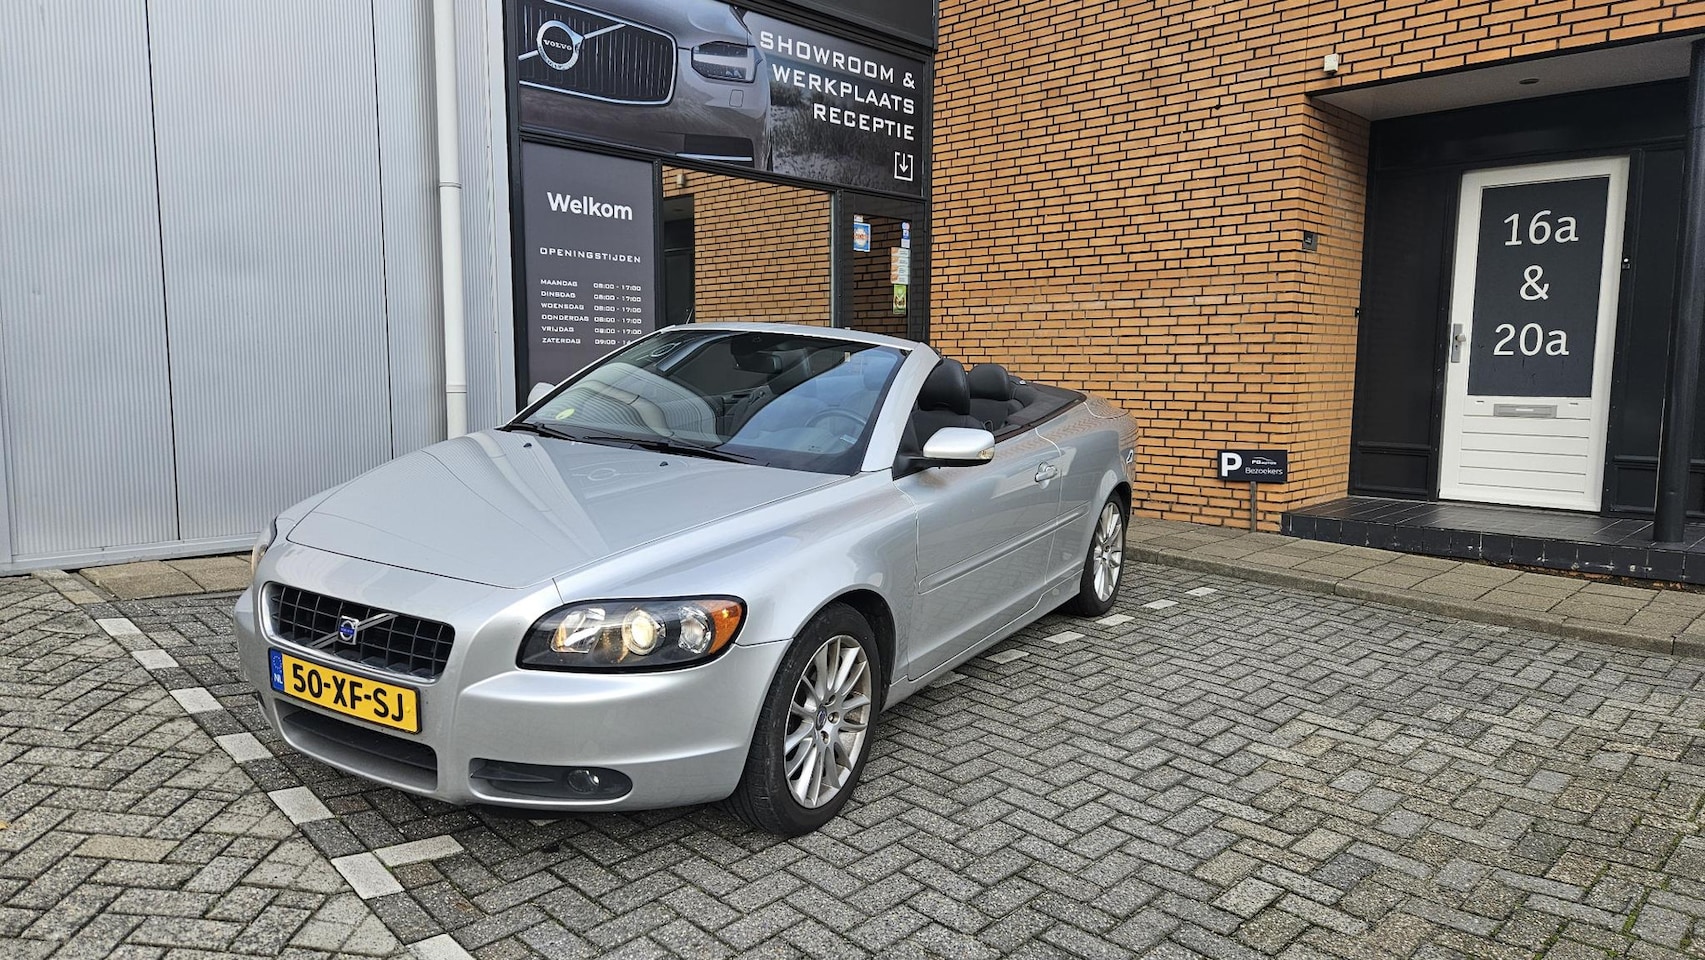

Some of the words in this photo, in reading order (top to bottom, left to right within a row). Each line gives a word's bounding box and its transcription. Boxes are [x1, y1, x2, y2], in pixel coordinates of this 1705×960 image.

[543, 39, 572, 51] VOLVO
[759, 31, 894, 83] SHOWROOM
[902, 72, 916, 89] &
[772, 64, 915, 115] WERKPLAATS
[813, 104, 915, 141] RECEPTIE
[546, 192, 633, 220] Welkom
[1503, 210, 1579, 246] 16a
[540, 247, 641, 263] OPENINGSTIJDEN
[540, 279, 578, 287] MAANDAG
[1519, 264, 1549, 301] &
[541, 314, 589, 322] DONDERDAG
[1493, 323, 1569, 356] 20a
[1221, 452, 1242, 477] P
[1244, 467, 1283, 475] Bezoekers
[274, 673, 283, 685] NL
[292, 663, 404, 722] 50-XF-SJ
